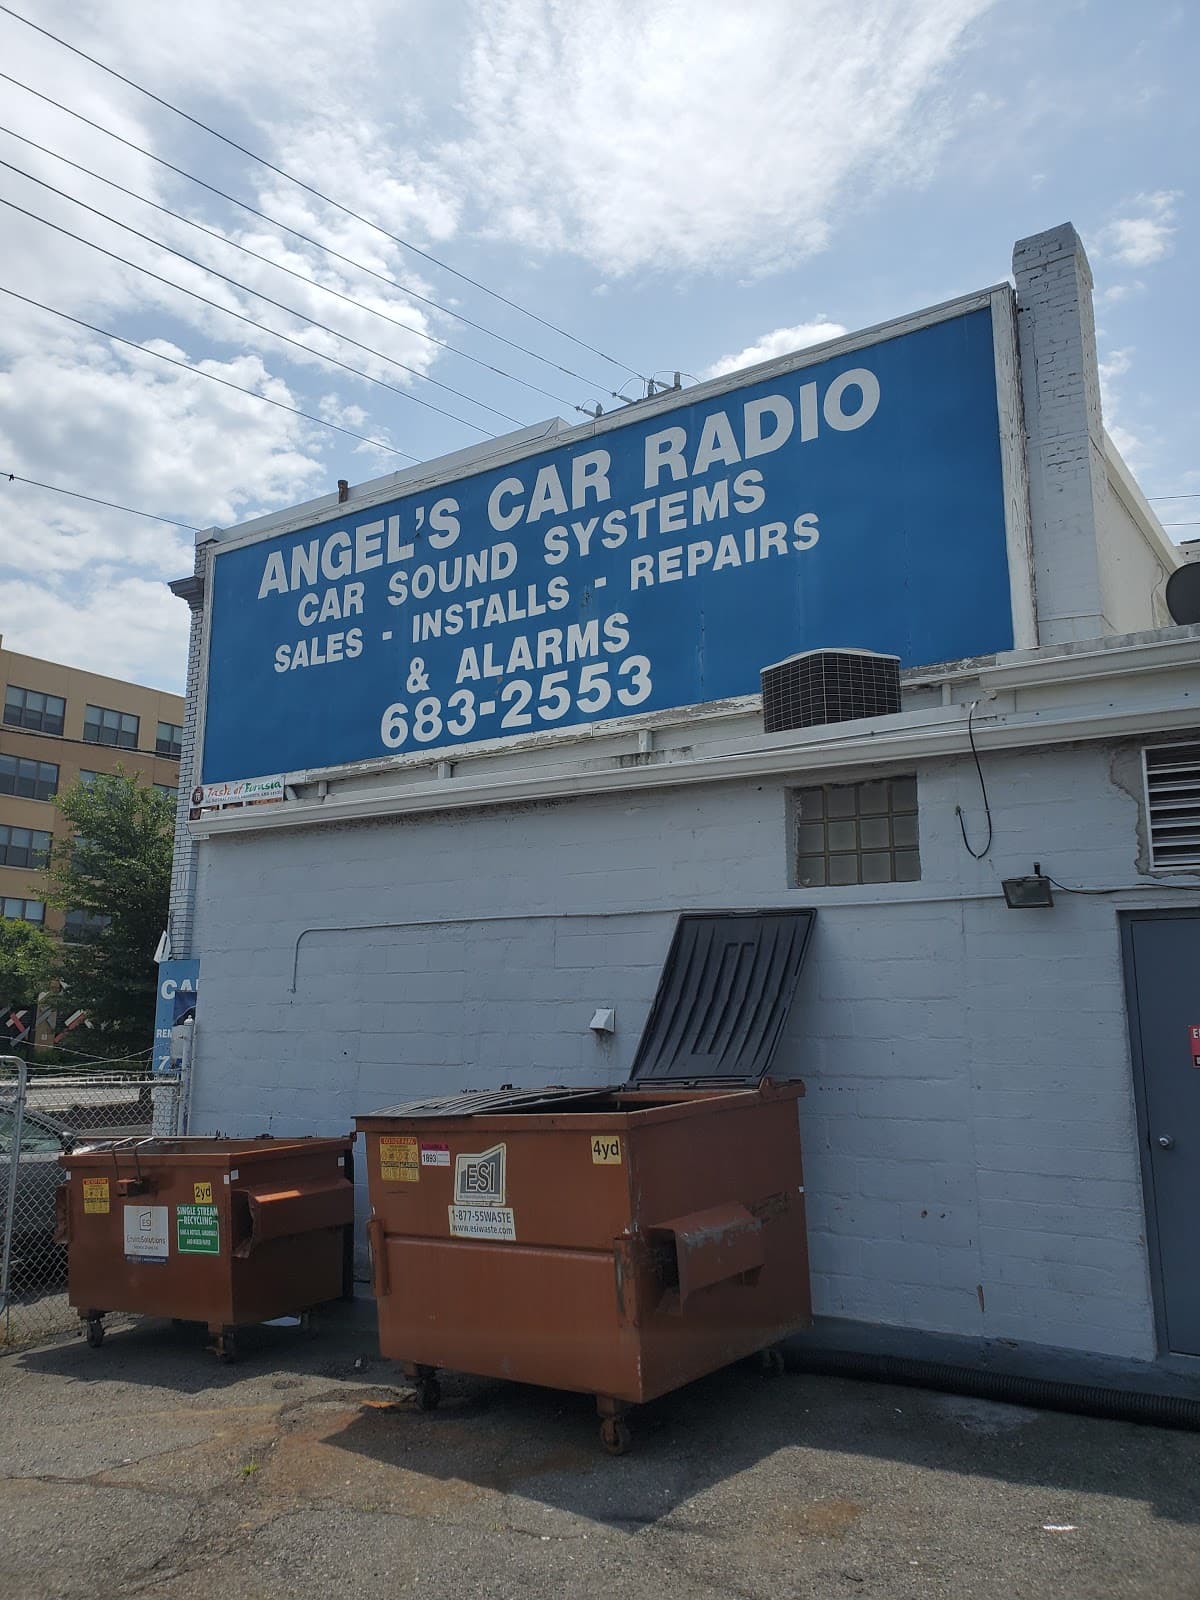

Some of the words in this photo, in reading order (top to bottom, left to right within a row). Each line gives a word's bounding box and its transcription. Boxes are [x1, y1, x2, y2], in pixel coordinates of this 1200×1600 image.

[257, 497, 461, 600] ANGEL'S
[487, 449, 611, 532] CAR
[644, 368, 881, 490] RADIO
[297, 581, 365, 627] CAR
[387, 541, 518, 606] SOUND
[543, 469, 766, 566] SYSTEMS
[274, 627, 363, 673] SALES
[412, 576, 570, 643] INSTALLS
[630, 512, 820, 591] REPAIRS
[406, 656, 430, 694] &
[455, 612, 630, 684] ALARMS
[380, 654, 653, 748] 683-2553
[161, 979, 199, 1000] CA
[593, 1139, 619, 1160] 4yd
[465, 1161, 496, 1192] ESI
[195, 1185, 212, 1200] 2yd
[176, 1206, 197, 1216] SINGLE
[197, 1206, 219, 1217] STREAM
[183, 1215, 214, 1226] RECYCLING
[451, 1209, 512, 1224] 1-877-55WASTE
[451, 1224, 514, 1236] www.esiwaste.com
